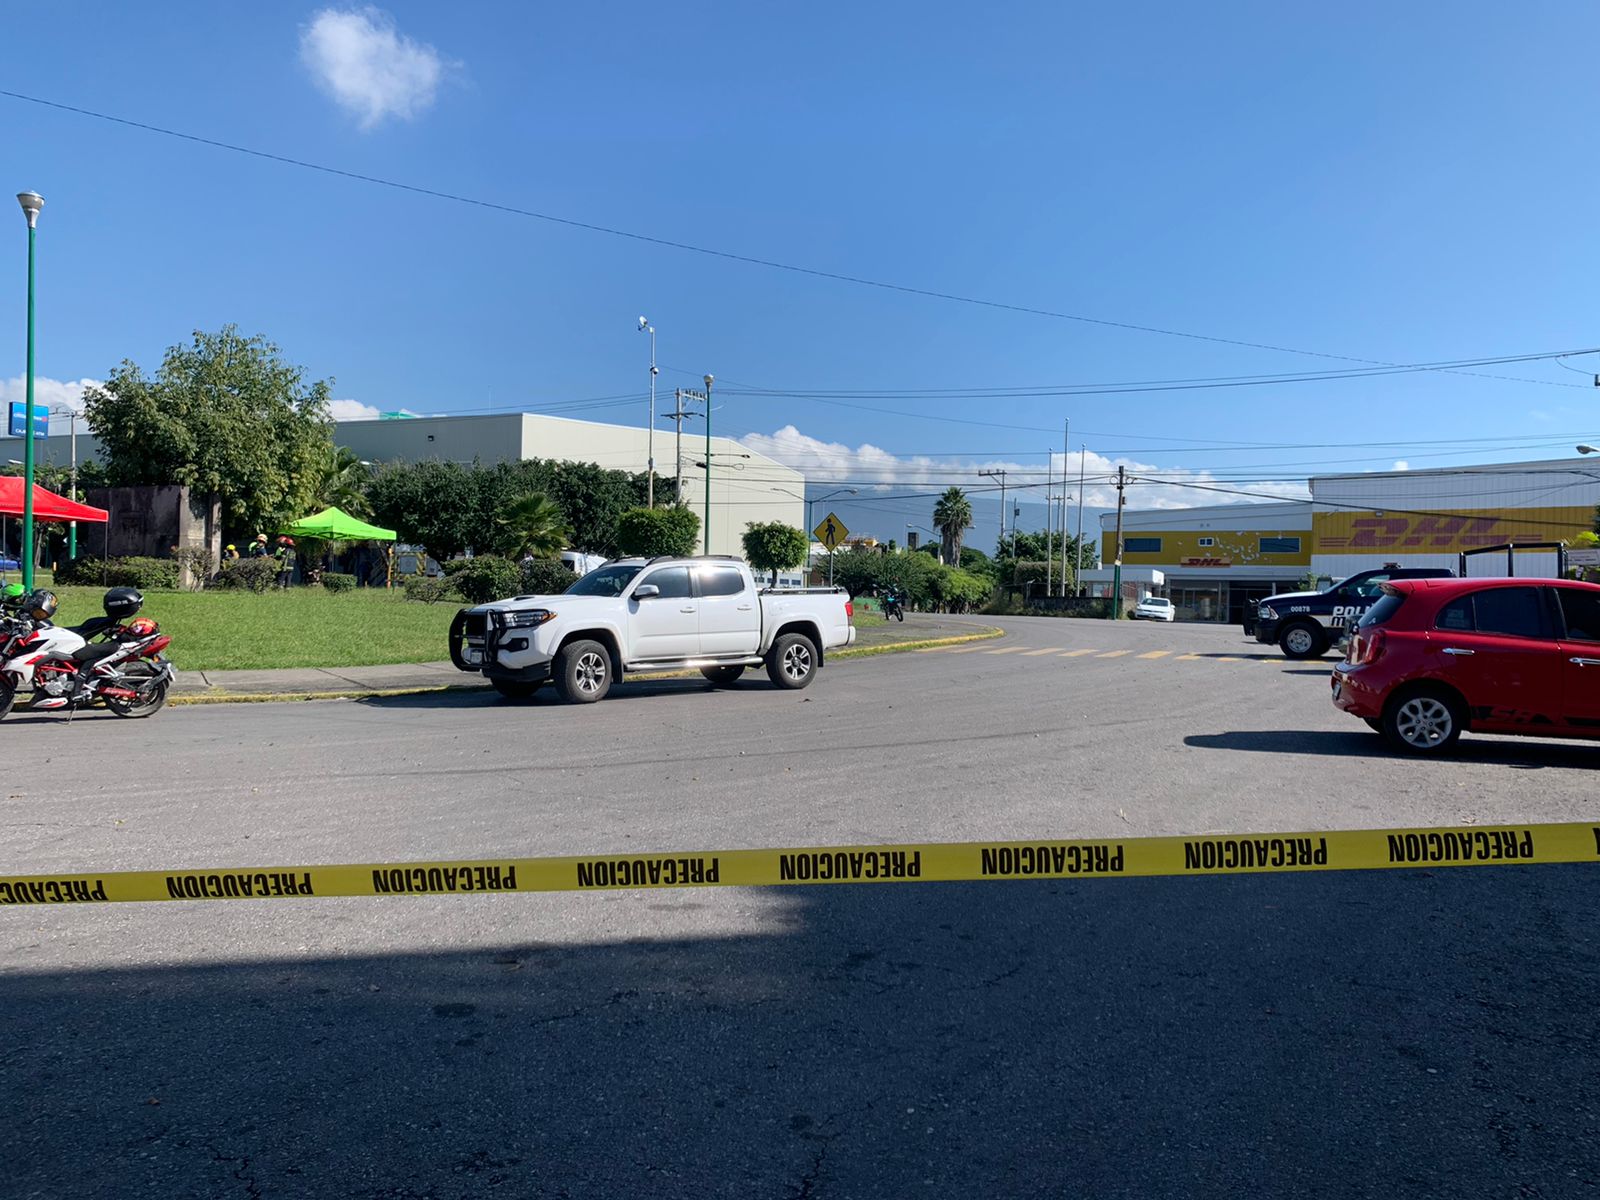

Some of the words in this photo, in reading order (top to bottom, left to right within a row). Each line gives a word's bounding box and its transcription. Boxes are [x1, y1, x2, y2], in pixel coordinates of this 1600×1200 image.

[1349, 516, 1512, 548] DHL
[1186, 558, 1223, 566] DHL
[1332, 605, 1374, 617] POLI
[981, 844, 1123, 876] PRECAUCION
[1184, 837, 1328, 870] PRECAUCION
[1386, 829, 1534, 864] PRECAUCION
[371, 866, 517, 893] PRECAUCION
[576, 858, 720, 887] PRECAUCION
[779, 851, 921, 881] PRECAUCION
[0, 879, 108, 902] PRECAUC
[166, 873, 314, 899] PRECAUCION
